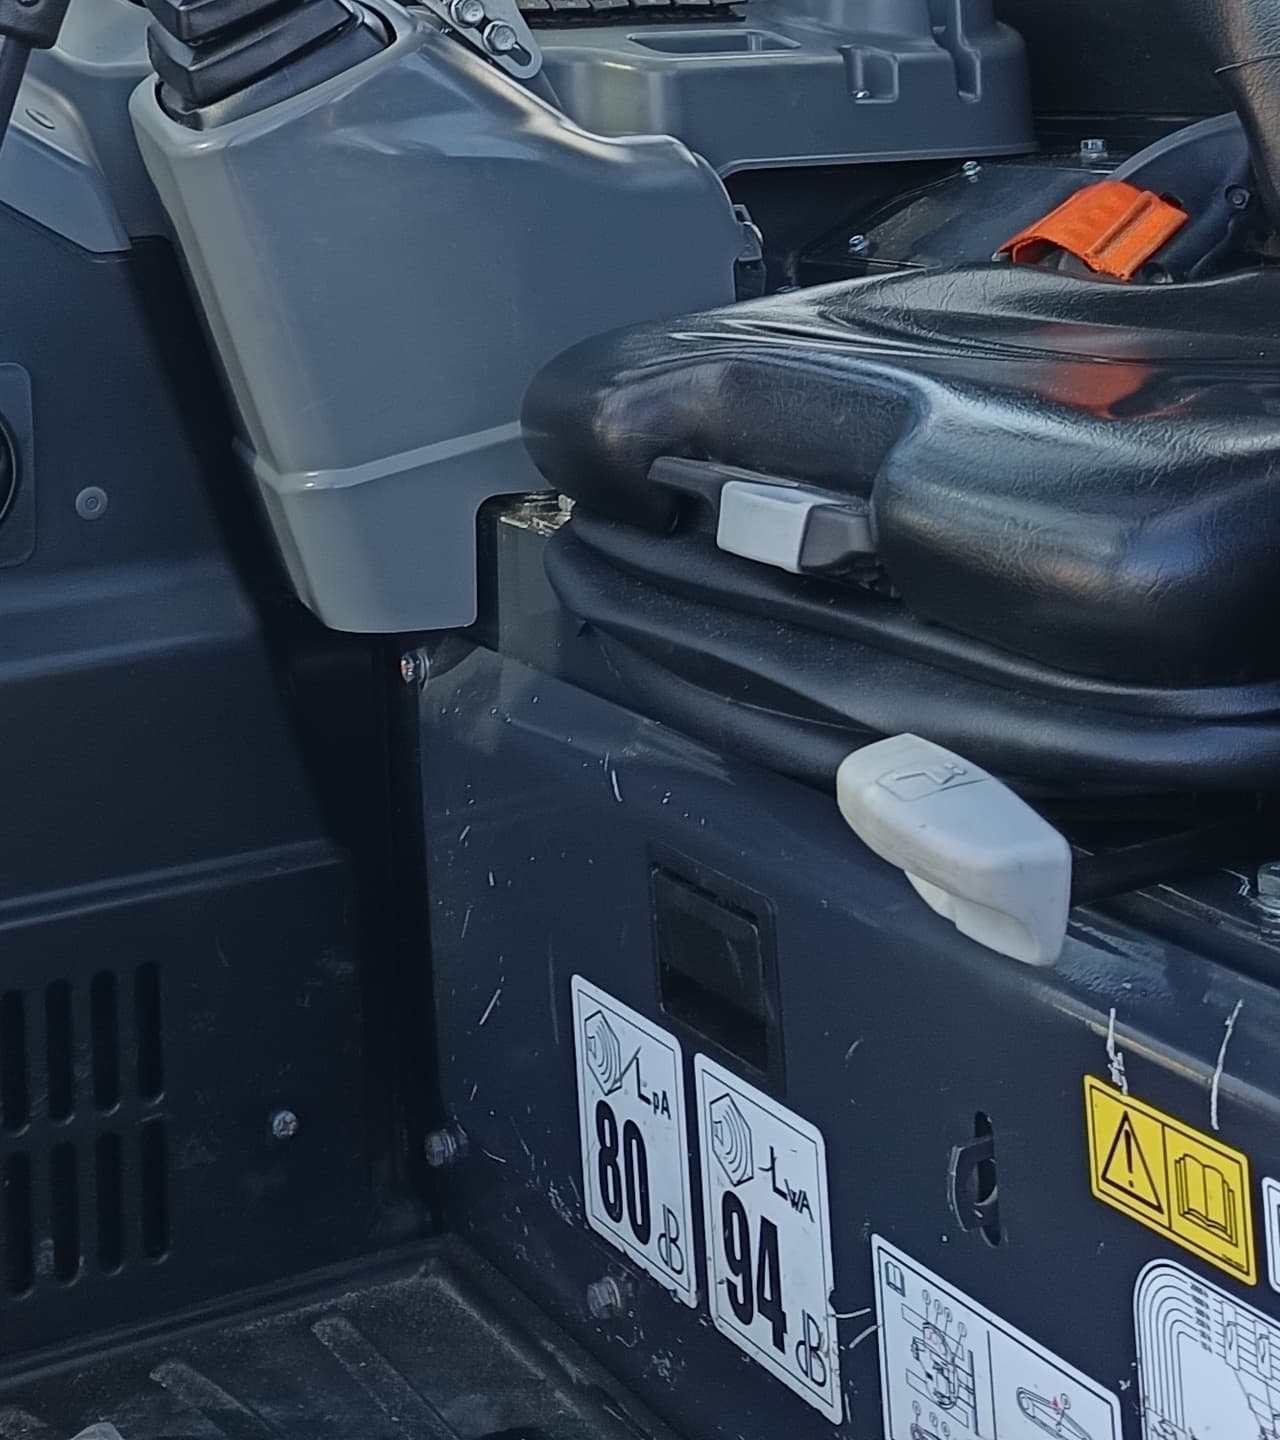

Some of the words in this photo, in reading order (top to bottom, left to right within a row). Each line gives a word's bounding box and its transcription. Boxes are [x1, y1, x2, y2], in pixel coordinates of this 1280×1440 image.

[595, 1099, 651, 1246] 80
[657, 1204, 685, 1275] dB
[721, 1189, 787, 1354] 94
[795, 1309, 828, 1388] dB
